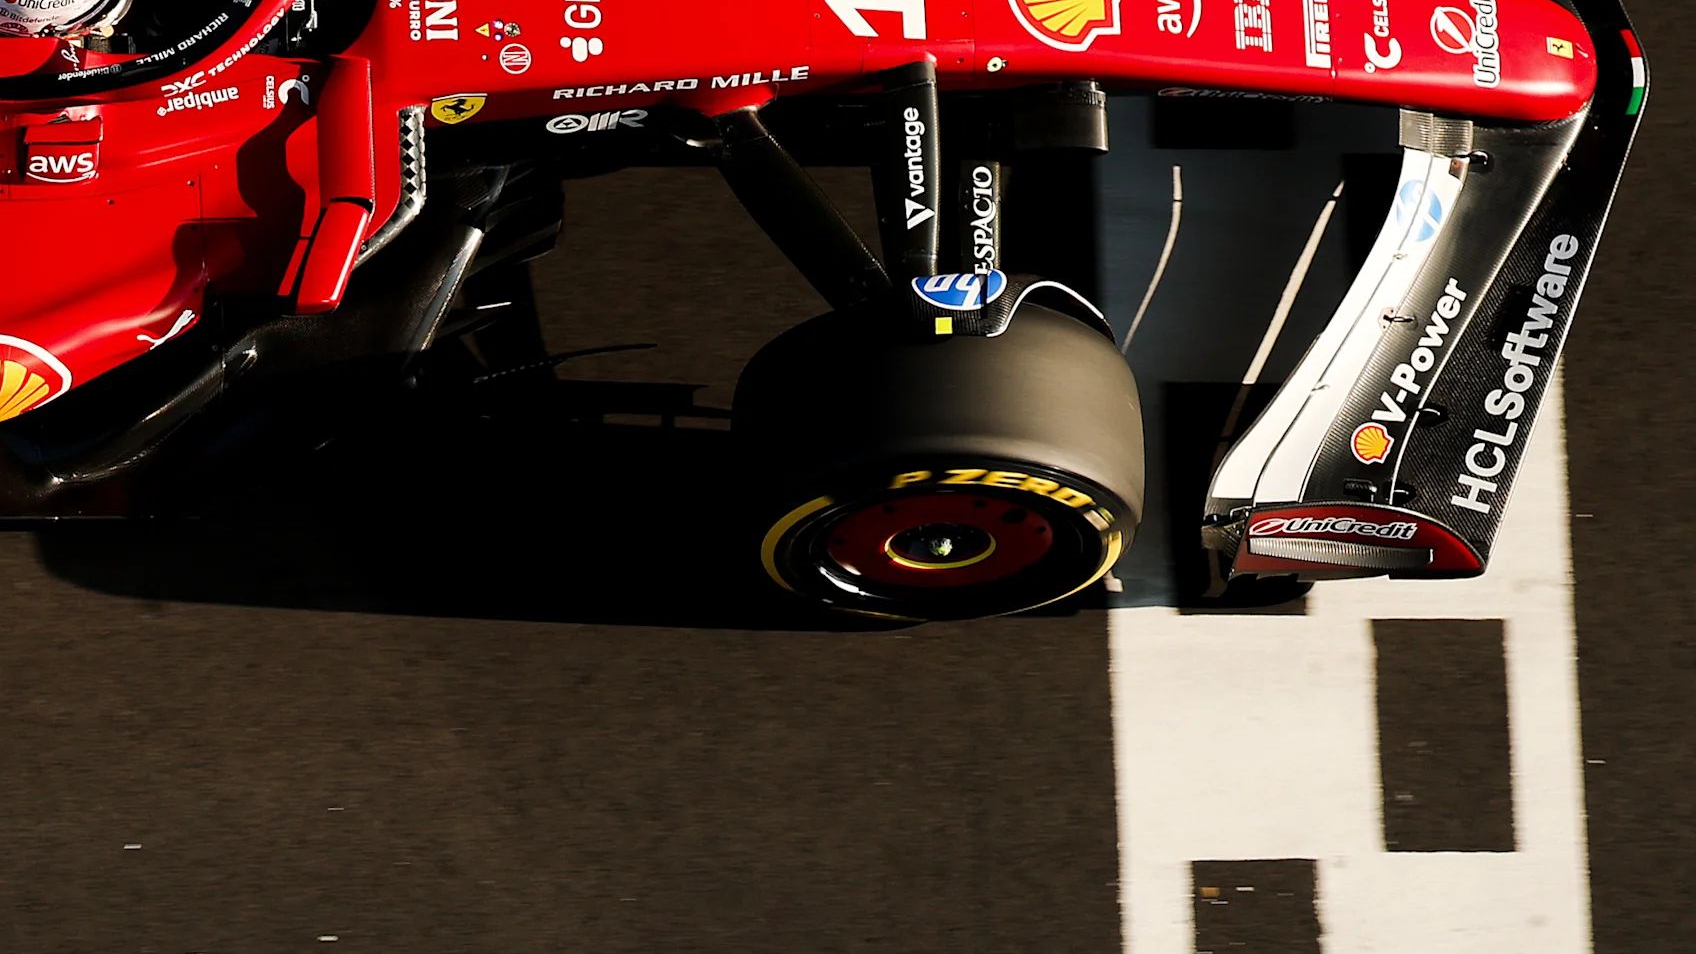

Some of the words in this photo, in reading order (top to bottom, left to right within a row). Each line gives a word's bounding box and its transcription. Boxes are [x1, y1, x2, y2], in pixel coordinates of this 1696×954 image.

[177, 13, 229, 51] RICHARD
[208, 8, 285, 77] TECHNOLOGY
[553, 78, 698, 100] RICHARD
[711, 66, 810, 88] MILLE
[26, 153, 94, 174] aws
[904, 107, 924, 198] vantage
[972, 166, 994, 275] ESPACIO
[1371, 277, 1468, 422] V-Power
[1451, 234, 1579, 514] HCLSoftware
[890, 471, 932, 489] P
[938, 469, 1097, 507] ZERO
[1284, 517, 1418, 540] UniCredit
